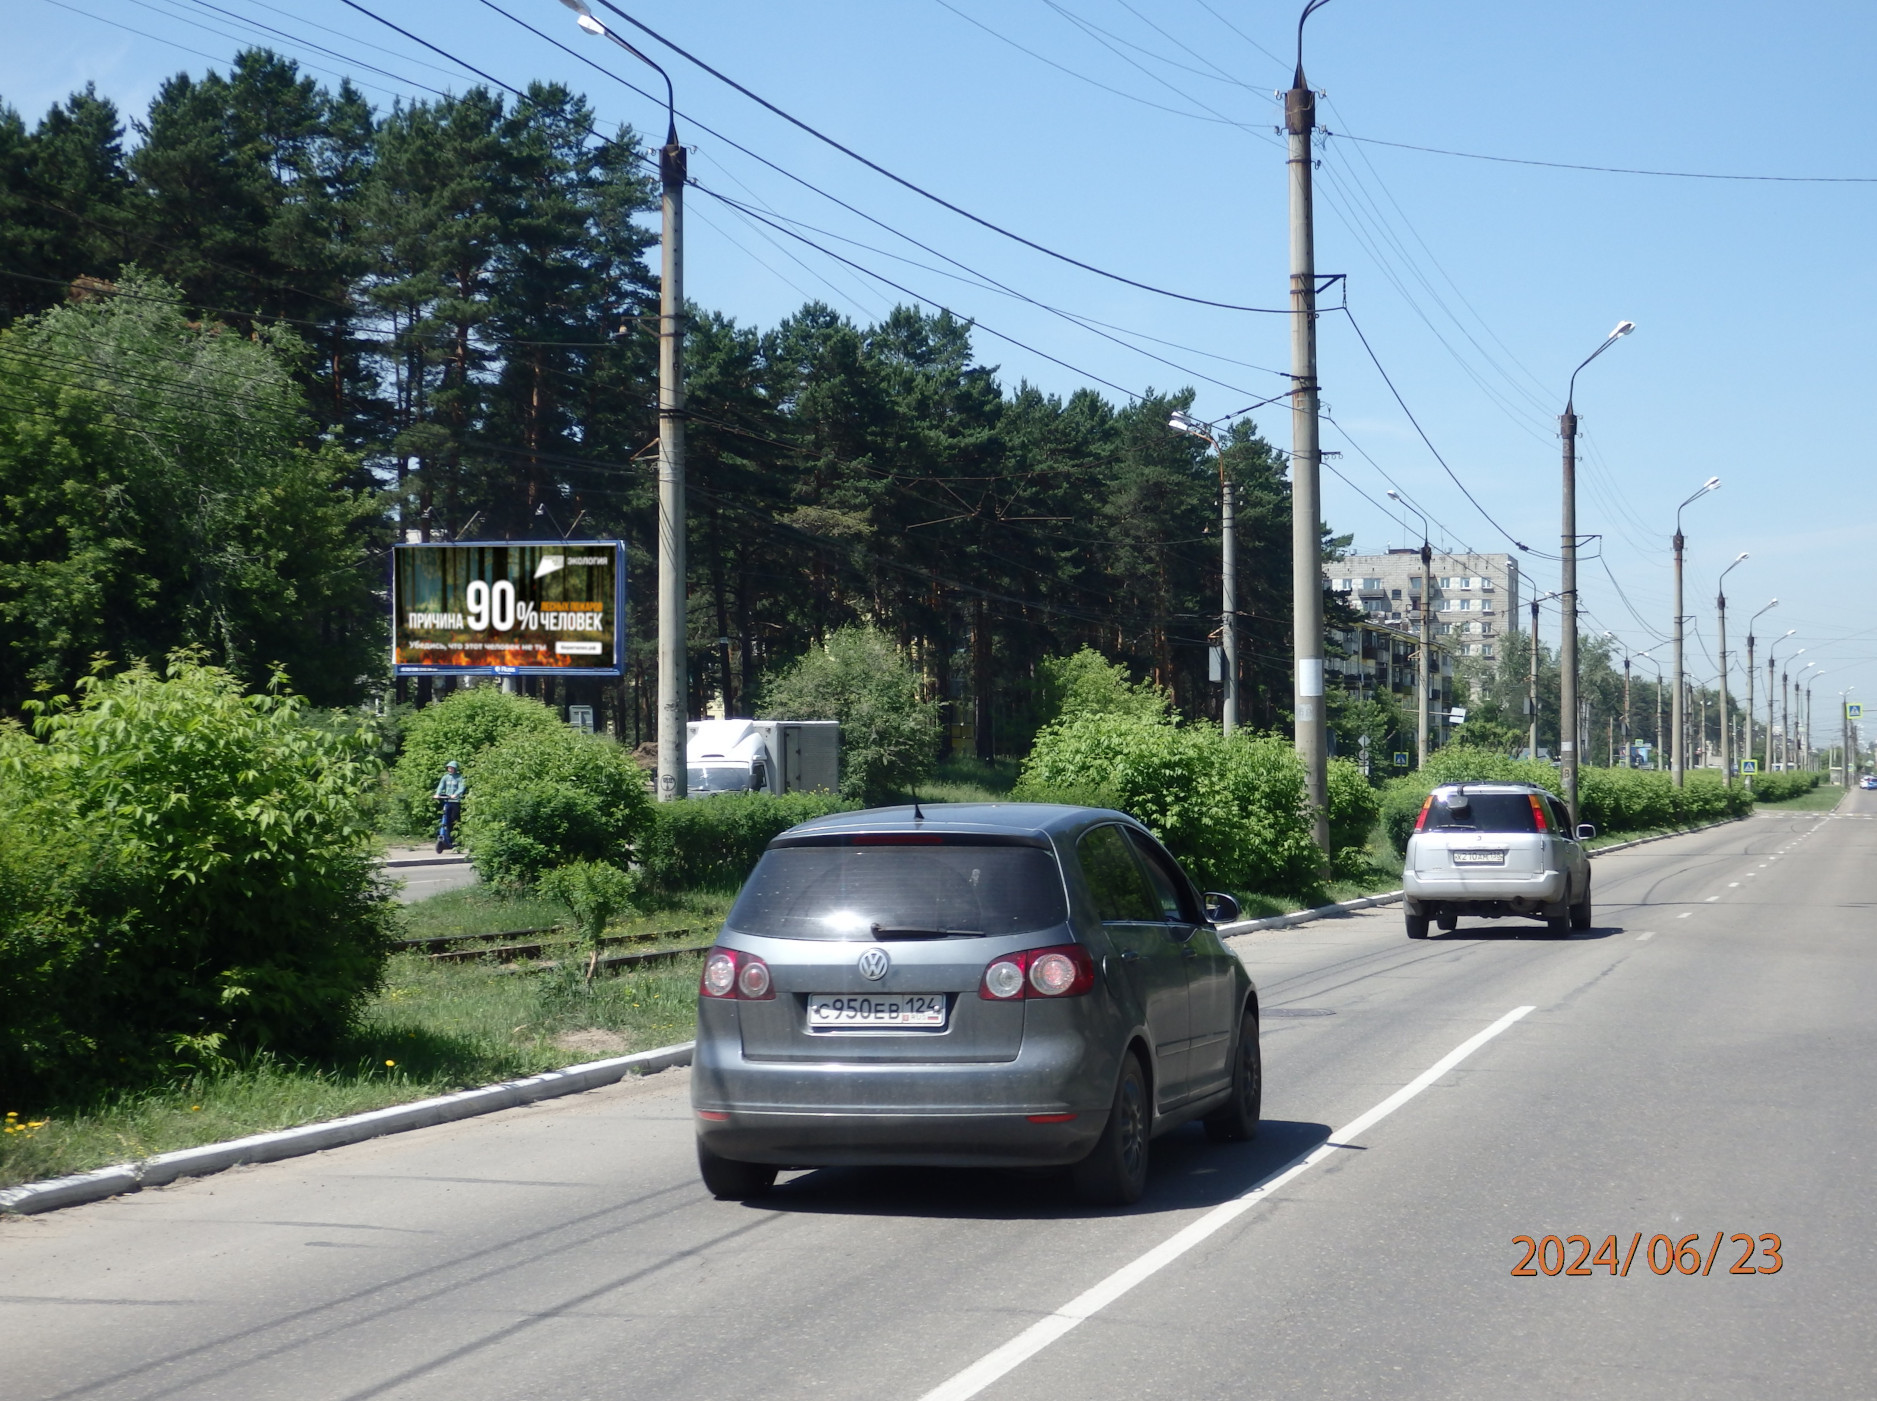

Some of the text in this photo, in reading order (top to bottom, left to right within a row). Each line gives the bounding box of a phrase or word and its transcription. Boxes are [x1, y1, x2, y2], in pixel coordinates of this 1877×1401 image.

[567, 556, 608, 566] ЭКОЛОГИЯ
[408, 612, 464, 630] ПРИЧИНА
[540, 612, 603, 632] ЧЕЛОВЕК
[408, 640, 447, 651] Убедись,
[447, 642, 463, 650] что
[484, 643, 521, 651] человек
[535, 644, 547, 652] ты
